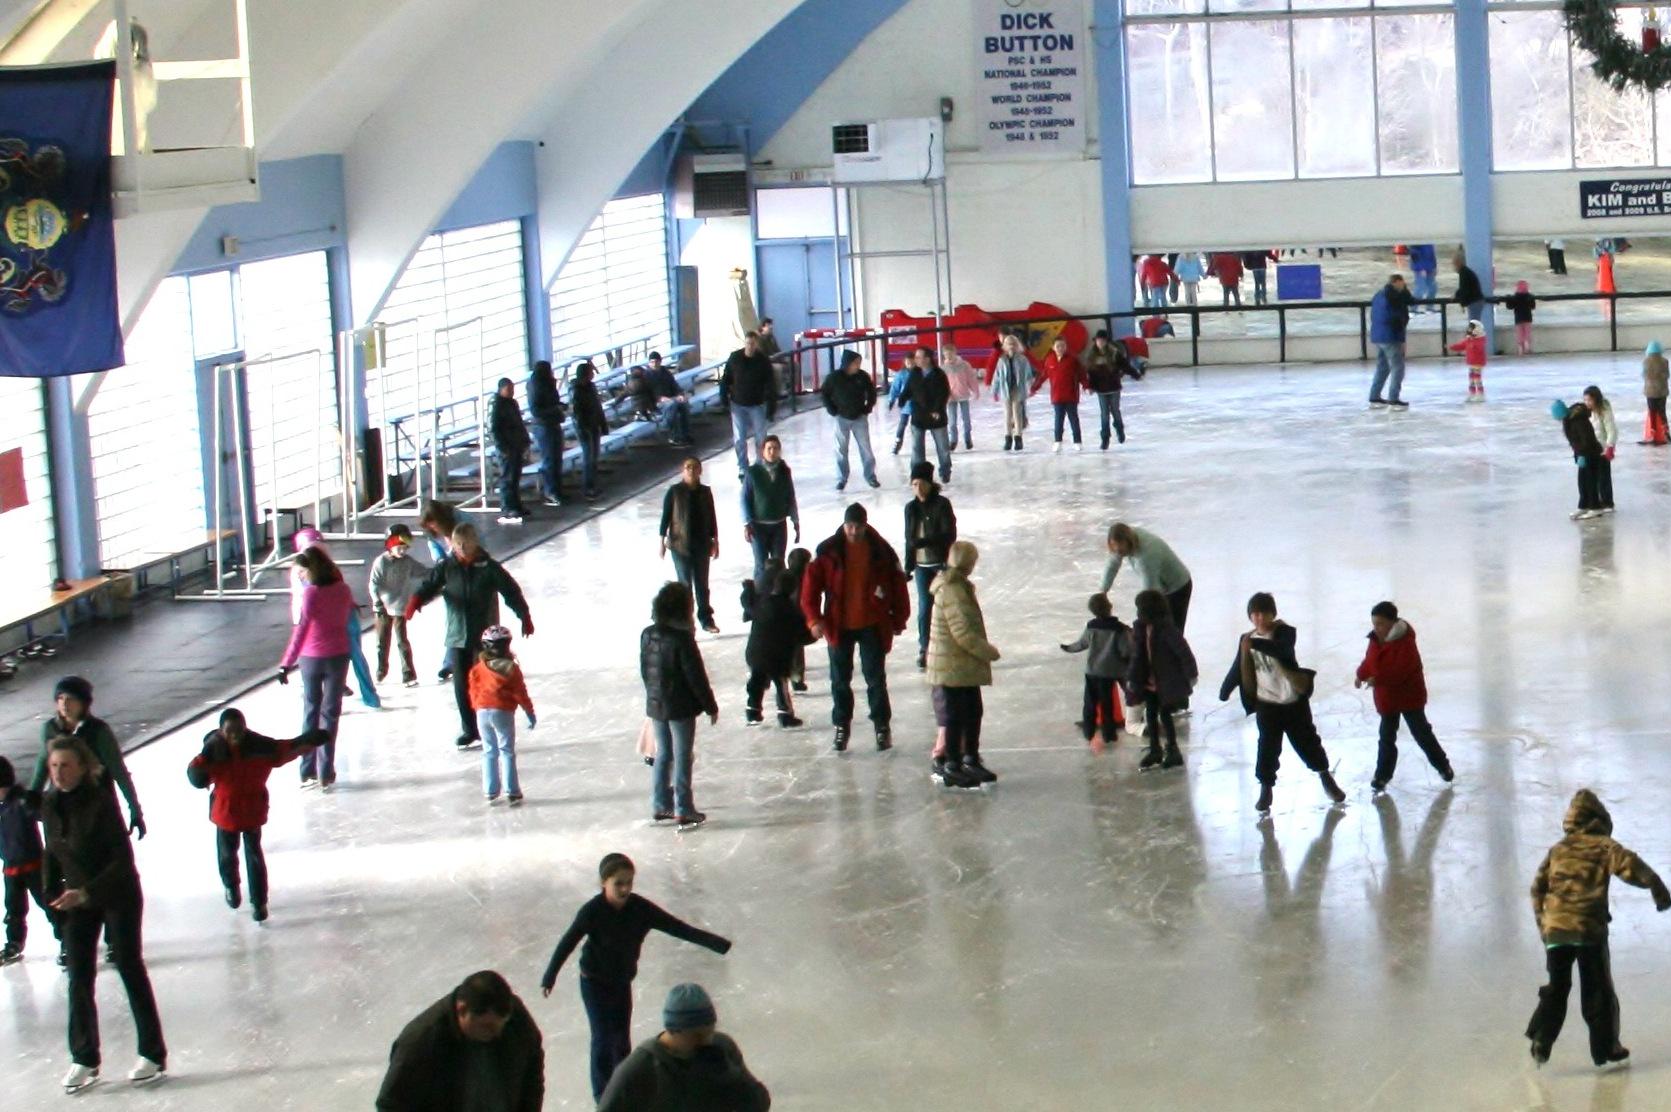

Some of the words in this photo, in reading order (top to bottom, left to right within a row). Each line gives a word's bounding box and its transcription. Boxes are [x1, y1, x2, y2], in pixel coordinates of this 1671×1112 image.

[1001, 13, 1054, 30] DICK
[985, 34, 1074, 53] BUTTON
[984, 69, 1026, 79] NATIONAL
[1030, 67, 1077, 77] CHAMPION
[991, 95, 1023, 104] WORLD
[1026, 93, 1072, 103] CHAMPION
[989, 120, 1025, 130] OLYMPIC
[1030, 118, 1075, 128] CHAMPION
[1587, 194, 1622, 207] KIM
[1628, 194, 1657, 206] and
[1609, 208, 1622, 216] and
